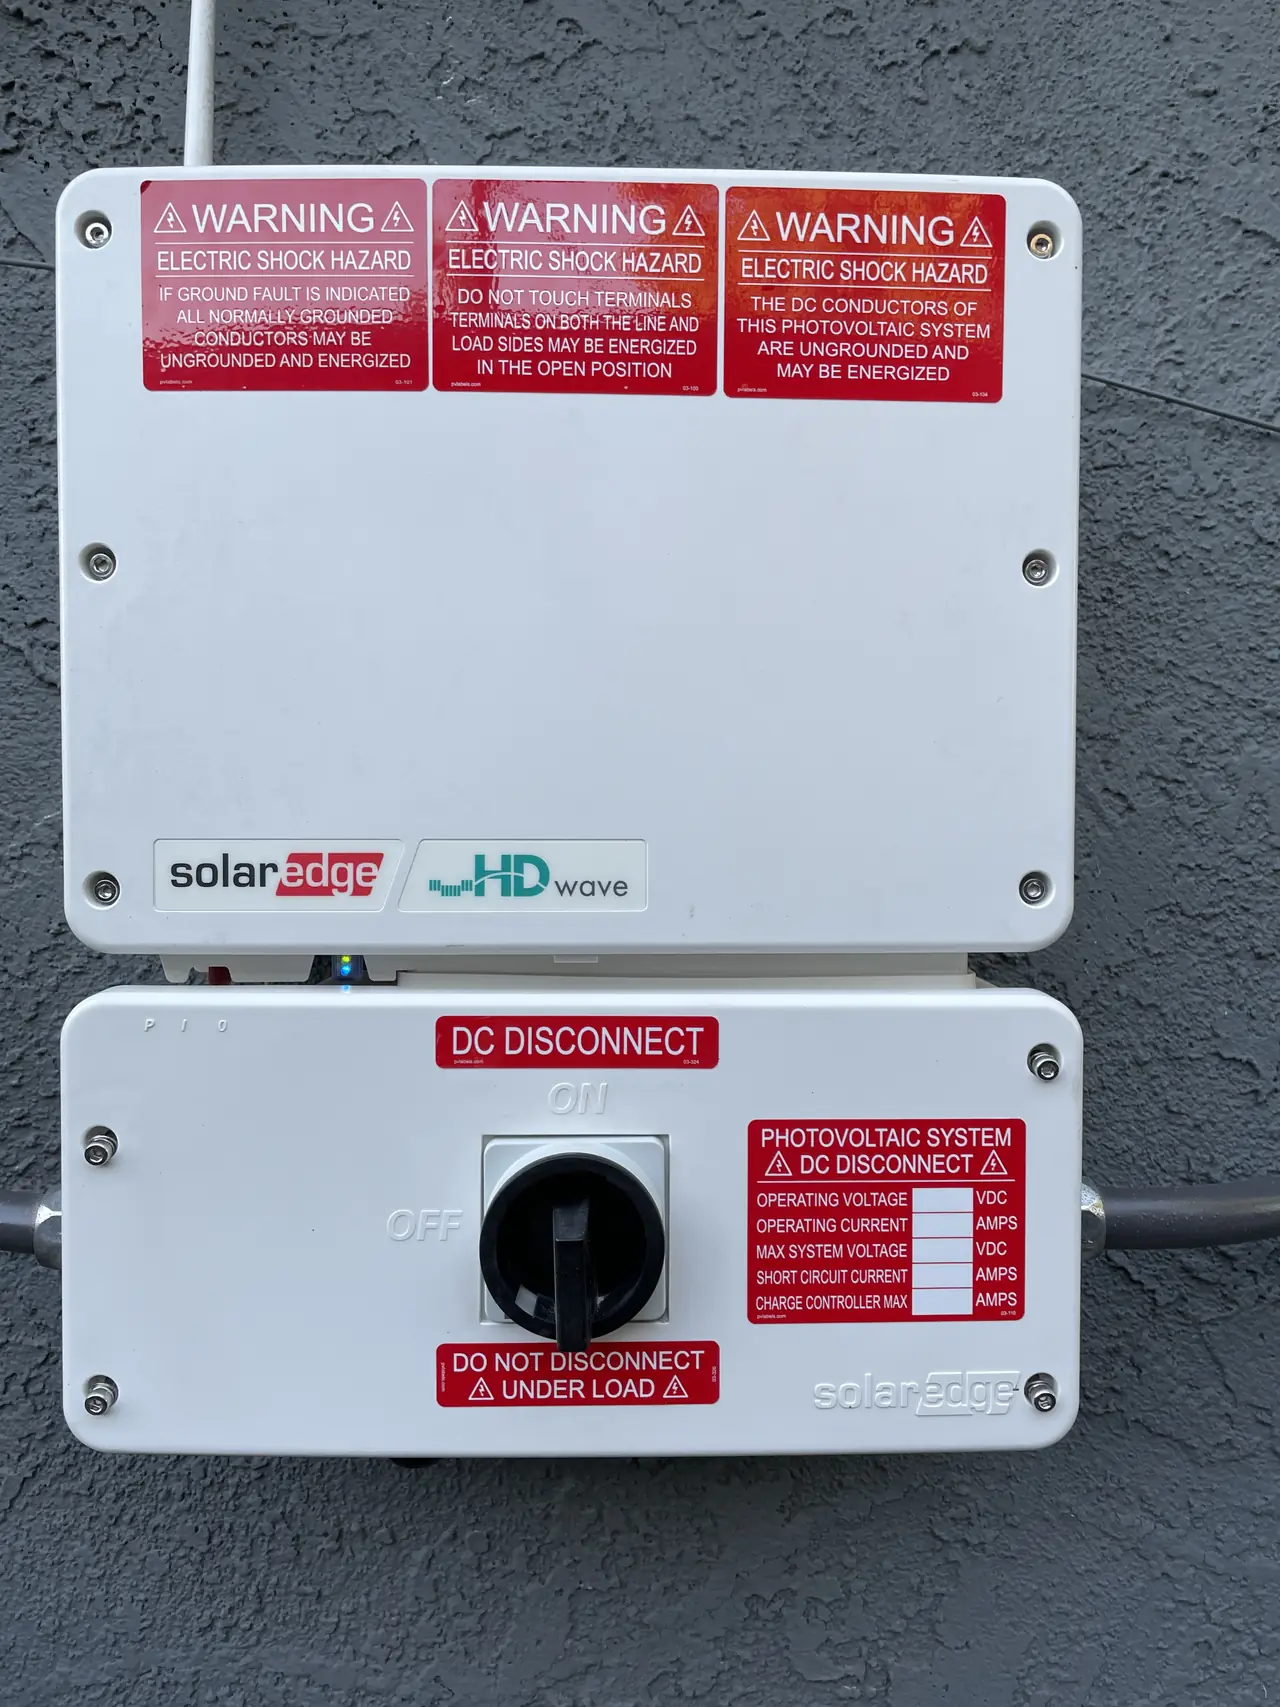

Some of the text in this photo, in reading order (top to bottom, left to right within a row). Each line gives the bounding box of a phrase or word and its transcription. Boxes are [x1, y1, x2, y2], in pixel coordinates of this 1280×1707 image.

[192, 202, 375, 233] WARNING
[483, 202, 667, 235] WARNING
[775, 212, 954, 246] WARNING
[157, 251, 412, 271] ELECTRIC SHOCK HAZARD
[448, 249, 702, 274] ELECTRIC SHOCK HAZARD
[742, 258, 988, 284] ELECTRIC SHOCK HAZARD
[159, 287, 410, 302] IF GROUND FAULT IS INDICATED
[458, 289, 692, 309] DO NOT TOUCH TERMINALS
[177, 309, 393, 324] ALL NORMALLY GROUNDED
[751, 297, 978, 317] THE DC CONDUCTORS OF
[450, 312, 699, 333] TERMINALS ON BOTH THE LINE AND
[737, 318, 991, 339] THIS PHOTOVOLTAIC SYSTEM
[194, 332, 372, 347] CONDUCTORS MAY BE
[452, 336, 697, 356] LOAD SIDES MAY BE ENERGIZED
[160, 353, 411, 368] UNGROUNDED AND ENERGIZED
[757, 341, 969, 360] ARE UNGROUNDED AND
[477, 360, 672, 379] IN THE OPEN POSITION
[777, 364, 950, 382] MAY BE ENERGIZED
[170, 853, 379, 897] solaredge
[474, 854, 629, 897] HD wave
[144, 1018, 156, 1032] P
[453, 1026, 705, 1056] DC DISCONNECT
[548, 1082, 609, 1115] ON
[761, 1128, 1011, 1148] PHOTOVOLTAIC SYSTEM
[801, 1154, 973, 1174] DC DISCONNECT
[757, 1191, 1008, 1207] OPERATING VOLTAGE VDC
[386, 1209, 464, 1242] OFF
[757, 1216, 1018, 1233] OPERATING CURRENT AMPS
[757, 1242, 1007, 1259] MAX SYSTEM VOLTAGE VDC
[757, 1267, 1018, 1285] SHORT CIRCUIT CURRENT AMPS
[756, 1293, 1017, 1310] CHARGE CONTROLLER MAX AMPS
[453, 1351, 705, 1372] DO NOT DISCONNECT
[502, 1379, 655, 1400] UNDER LOAD
[813, 1373, 1015, 1412] solaredge
